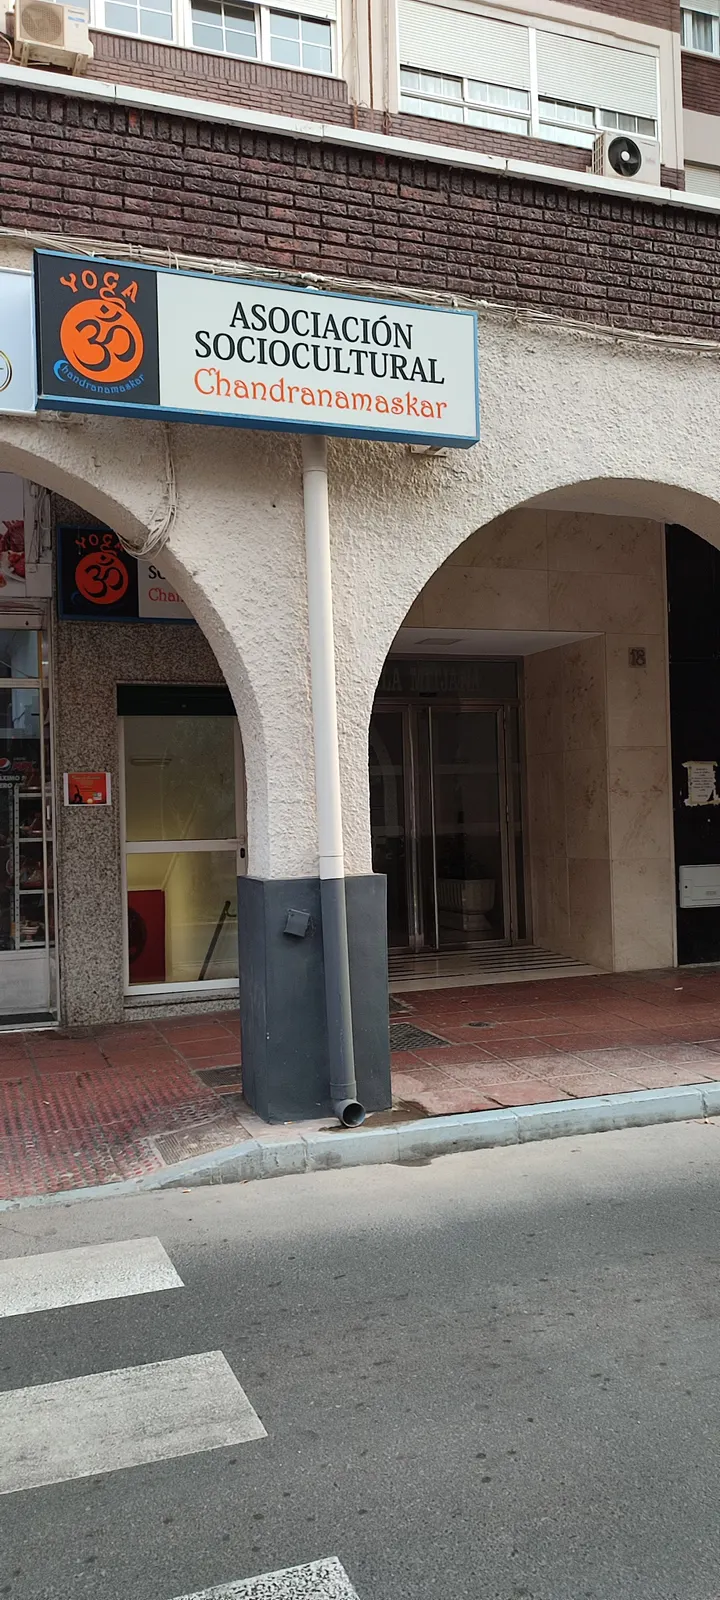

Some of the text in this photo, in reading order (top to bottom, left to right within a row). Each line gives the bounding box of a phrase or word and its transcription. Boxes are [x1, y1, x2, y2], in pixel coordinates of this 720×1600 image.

[59, 269, 139, 304] YOGA
[229, 301, 413, 350] ASOCIACIÓN
[53, 359, 145, 394] Chandranamaskar
[194, 330, 445, 384] SOCIOCULTURAL
[193, 367, 448, 419] Chandranamaskar
[629, 648, 646, 666] 18
